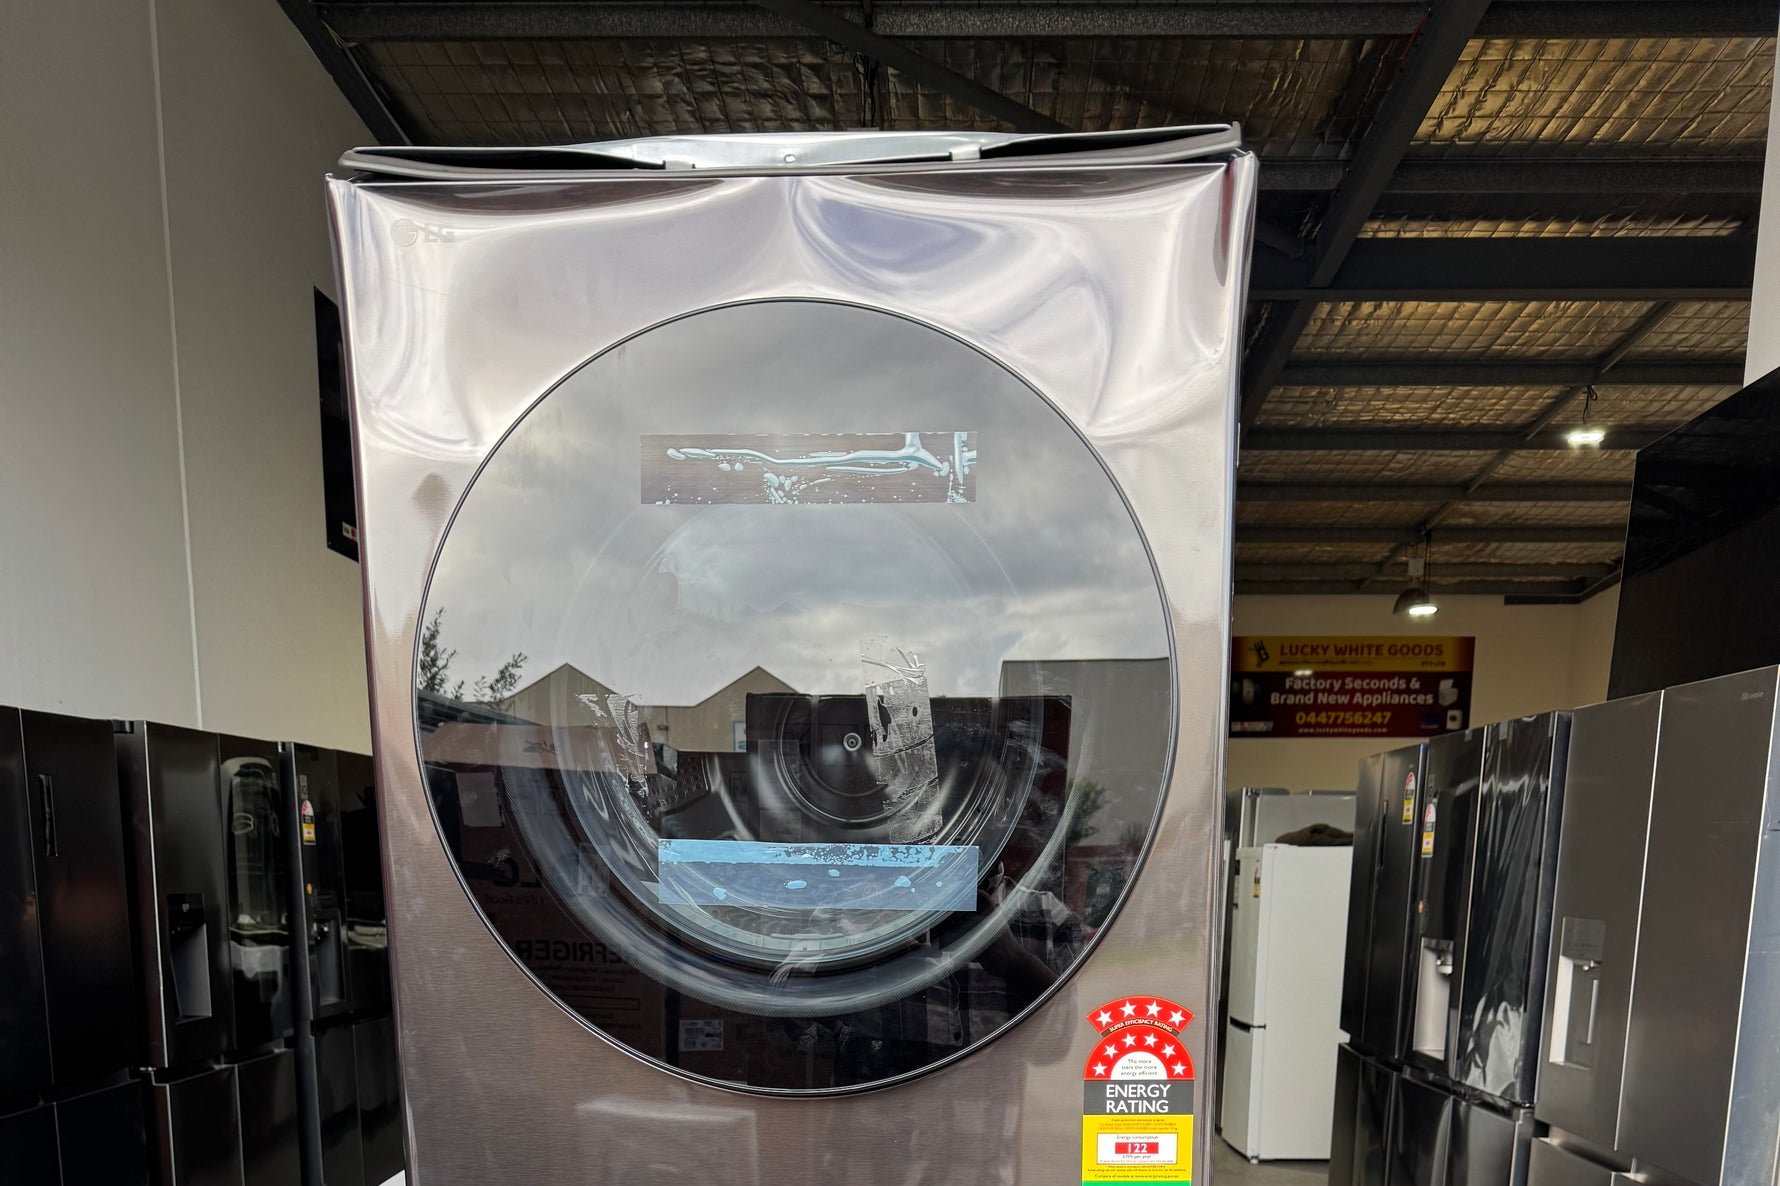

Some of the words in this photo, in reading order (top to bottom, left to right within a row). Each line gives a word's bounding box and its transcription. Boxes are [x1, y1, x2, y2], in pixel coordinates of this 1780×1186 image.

[1280, 644, 1331, 657] LUCKY
[1333, 644, 1384, 657] WHITE
[1388, 644, 1444, 657] GOODS
[1285, 677, 1342, 692] Factory
[1345, 676, 1406, 690] Seconds
[1410, 677, 1420, 689] &
[1271, 692, 1315, 705] Brand
[1317, 692, 1350, 705] New
[1353, 691, 1433, 707] Appliances
[1296, 712, 1391, 725] 0447756247
[1109, 1022, 1125, 1032] SUPER
[1154, 1021, 1173, 1032] RATING
[1106, 1084, 1171, 1098] ENERGY
[1106, 1100, 1169, 1113] RATING
[1128, 1143, 1147, 1153] 122
